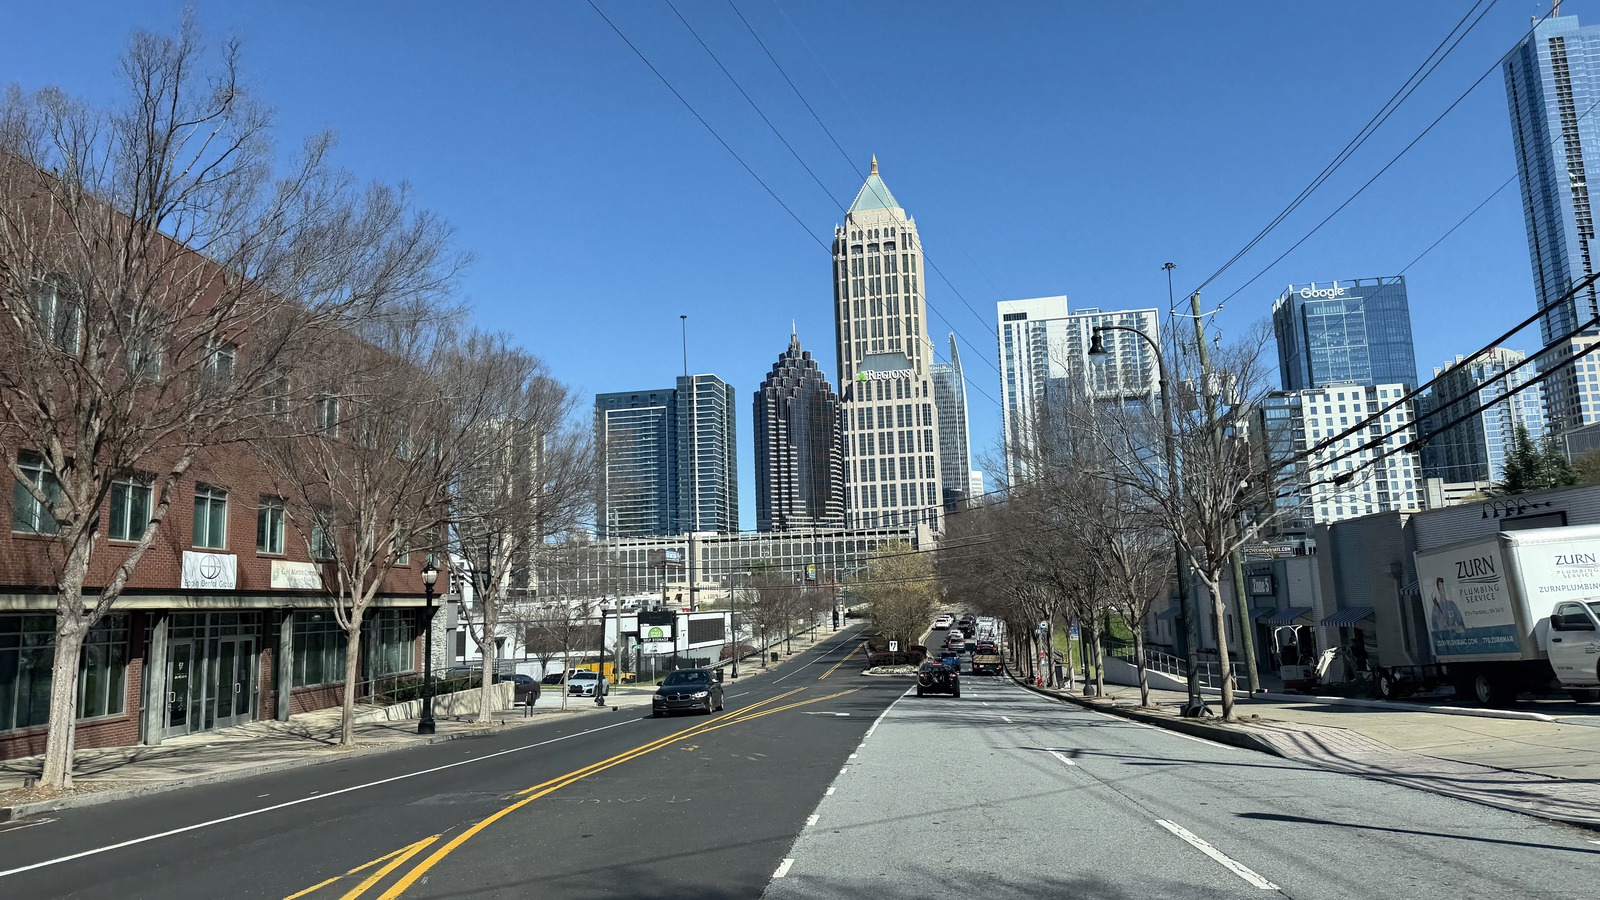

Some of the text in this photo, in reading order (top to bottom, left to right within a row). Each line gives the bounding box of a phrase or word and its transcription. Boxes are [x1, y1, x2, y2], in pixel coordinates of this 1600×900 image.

[1300, 287, 1344, 299] Google
[868, 369, 911, 380] REGIONS
[1555, 553, 1596, 565] ZURN
[1455, 555, 1495, 579] ZURN
[200, 579, 216, 587] Dental
[1539, 583, 1600, 593] ZURNPLUMBIN
[1459, 584, 1500, 597] PLUMBING
[1466, 593, 1496, 604] SERVICE
